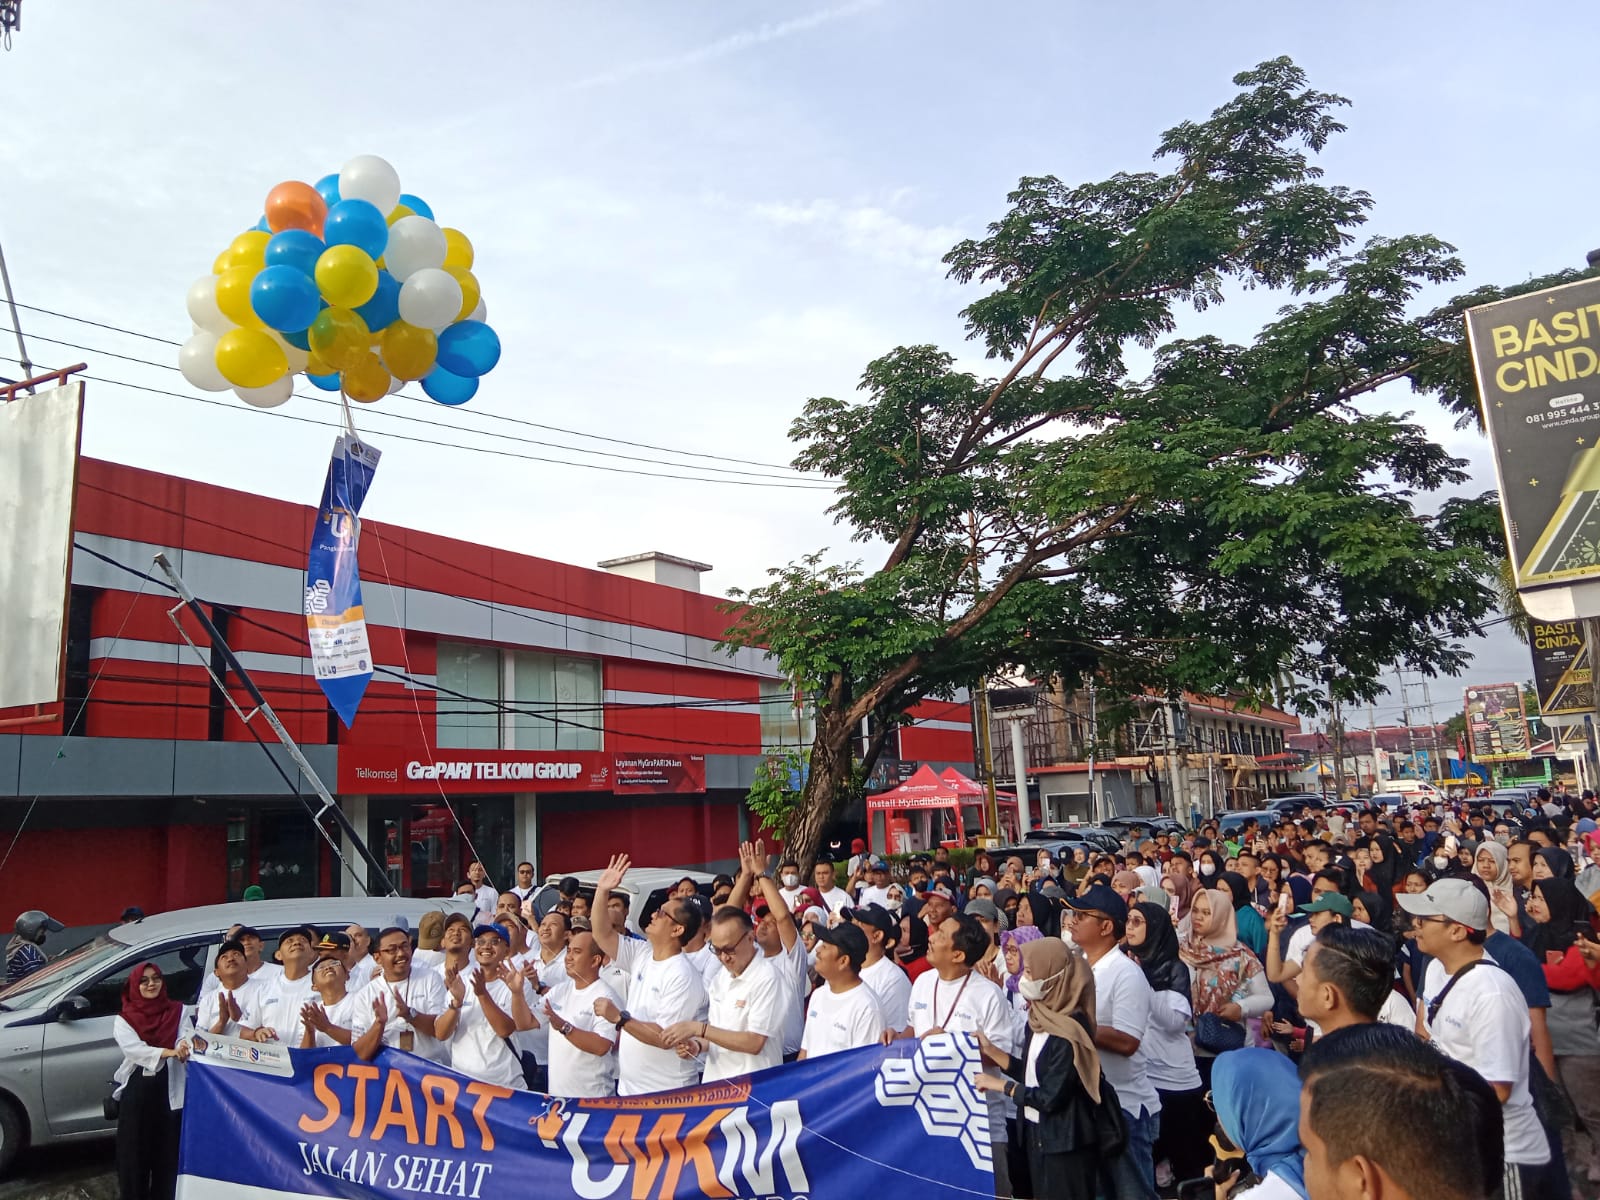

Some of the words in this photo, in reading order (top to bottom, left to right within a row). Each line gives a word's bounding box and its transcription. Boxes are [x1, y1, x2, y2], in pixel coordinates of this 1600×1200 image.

[1492, 303, 1600, 358] BASIT
[1495, 346, 1600, 393] CIND
[1525, 413, 1545, 424] 081
[1547, 409, 1567, 420] 995
[1569, 404, 1590, 415] 444
[1592, 401, 1600, 411] 3
[1535, 622, 1576, 637] BASIT
[1535, 635, 1581, 650] CINDA
[355, 767, 398, 782] Telkomsel
[406, 761, 473, 780] GraPARI
[474, 763, 534, 779] TELKOM
[535, 763, 582, 779] GROUP
[868, 799, 896, 808] Install
[298, 1063, 514, 1152] START
[562, 1100, 810, 1200] UMKM
[298, 1142, 386, 1186] JALAN
[387, 1154, 493, 1199] SEHAT
